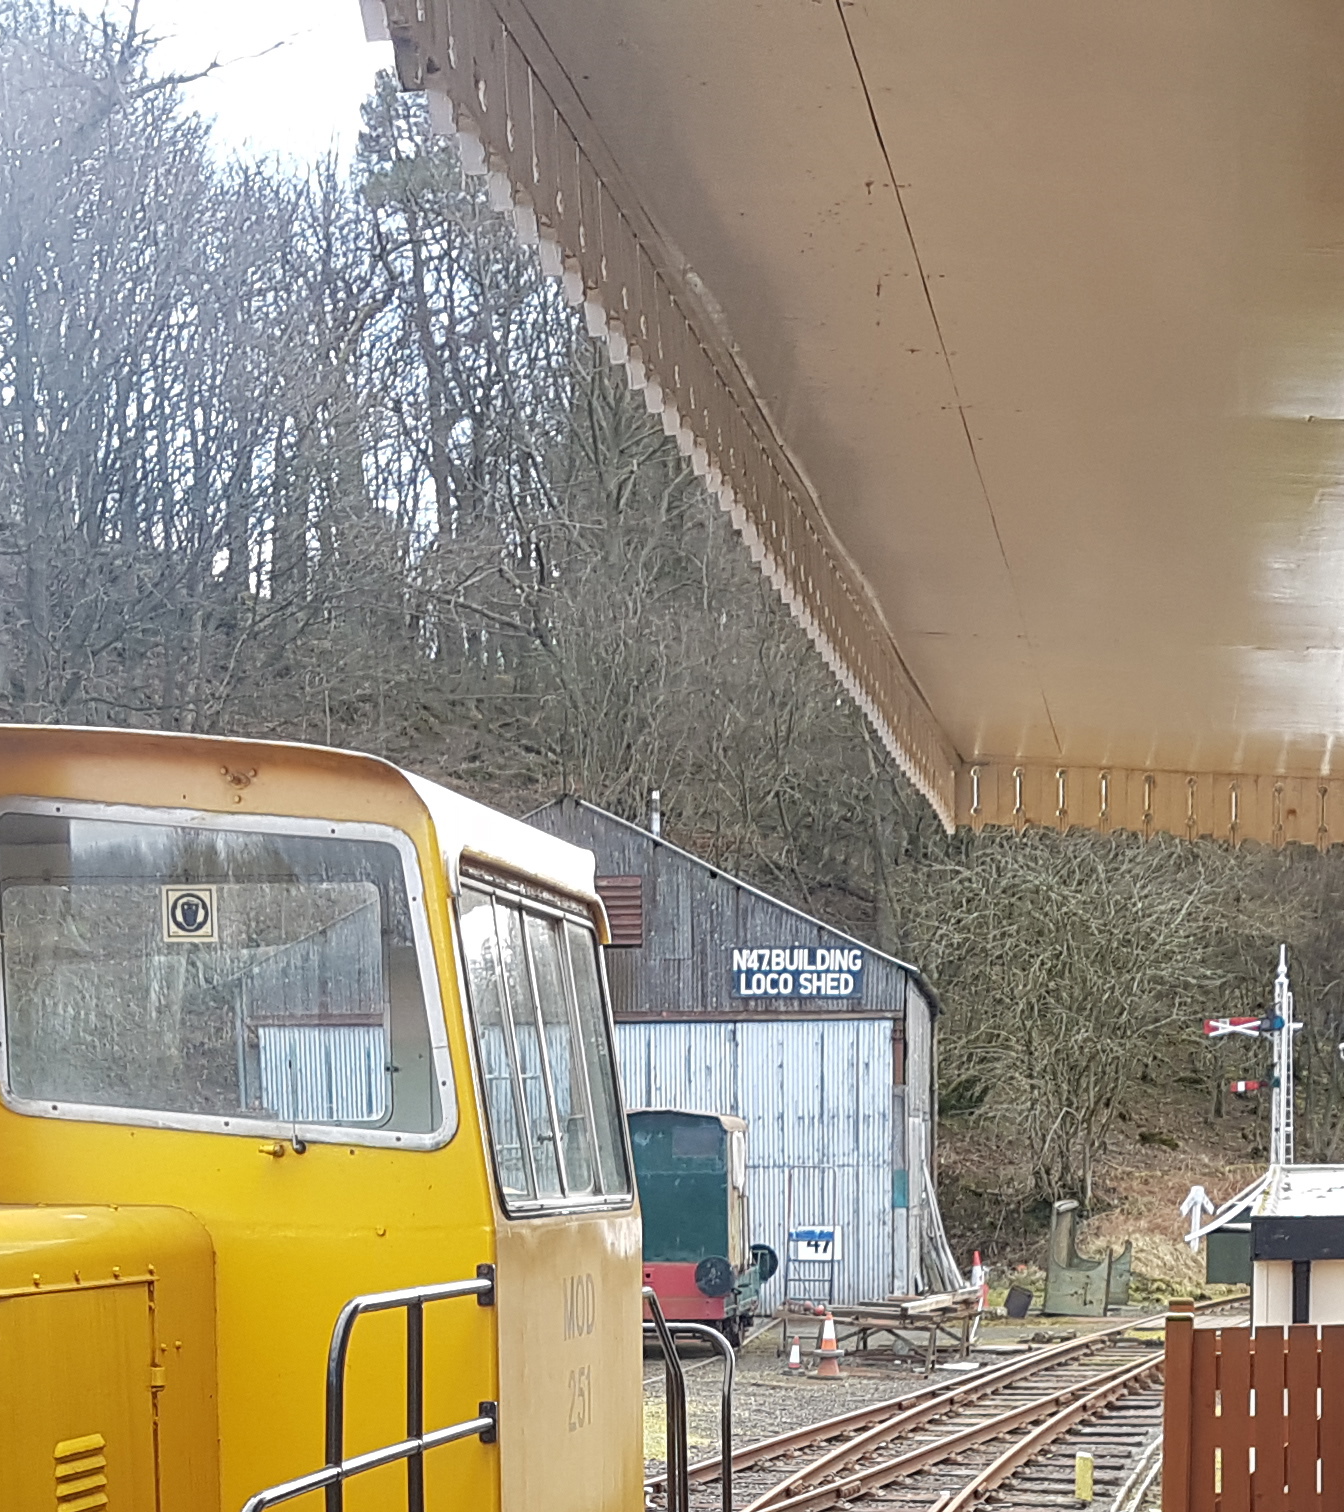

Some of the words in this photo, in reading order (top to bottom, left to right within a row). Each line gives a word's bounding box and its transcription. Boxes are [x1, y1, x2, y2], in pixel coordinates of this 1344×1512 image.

[740, 973, 793, 995] LOCO
[799, 973, 854, 995] SHED
[563, 1273, 596, 1341] MOD
[568, 1365, 592, 1433] 251
